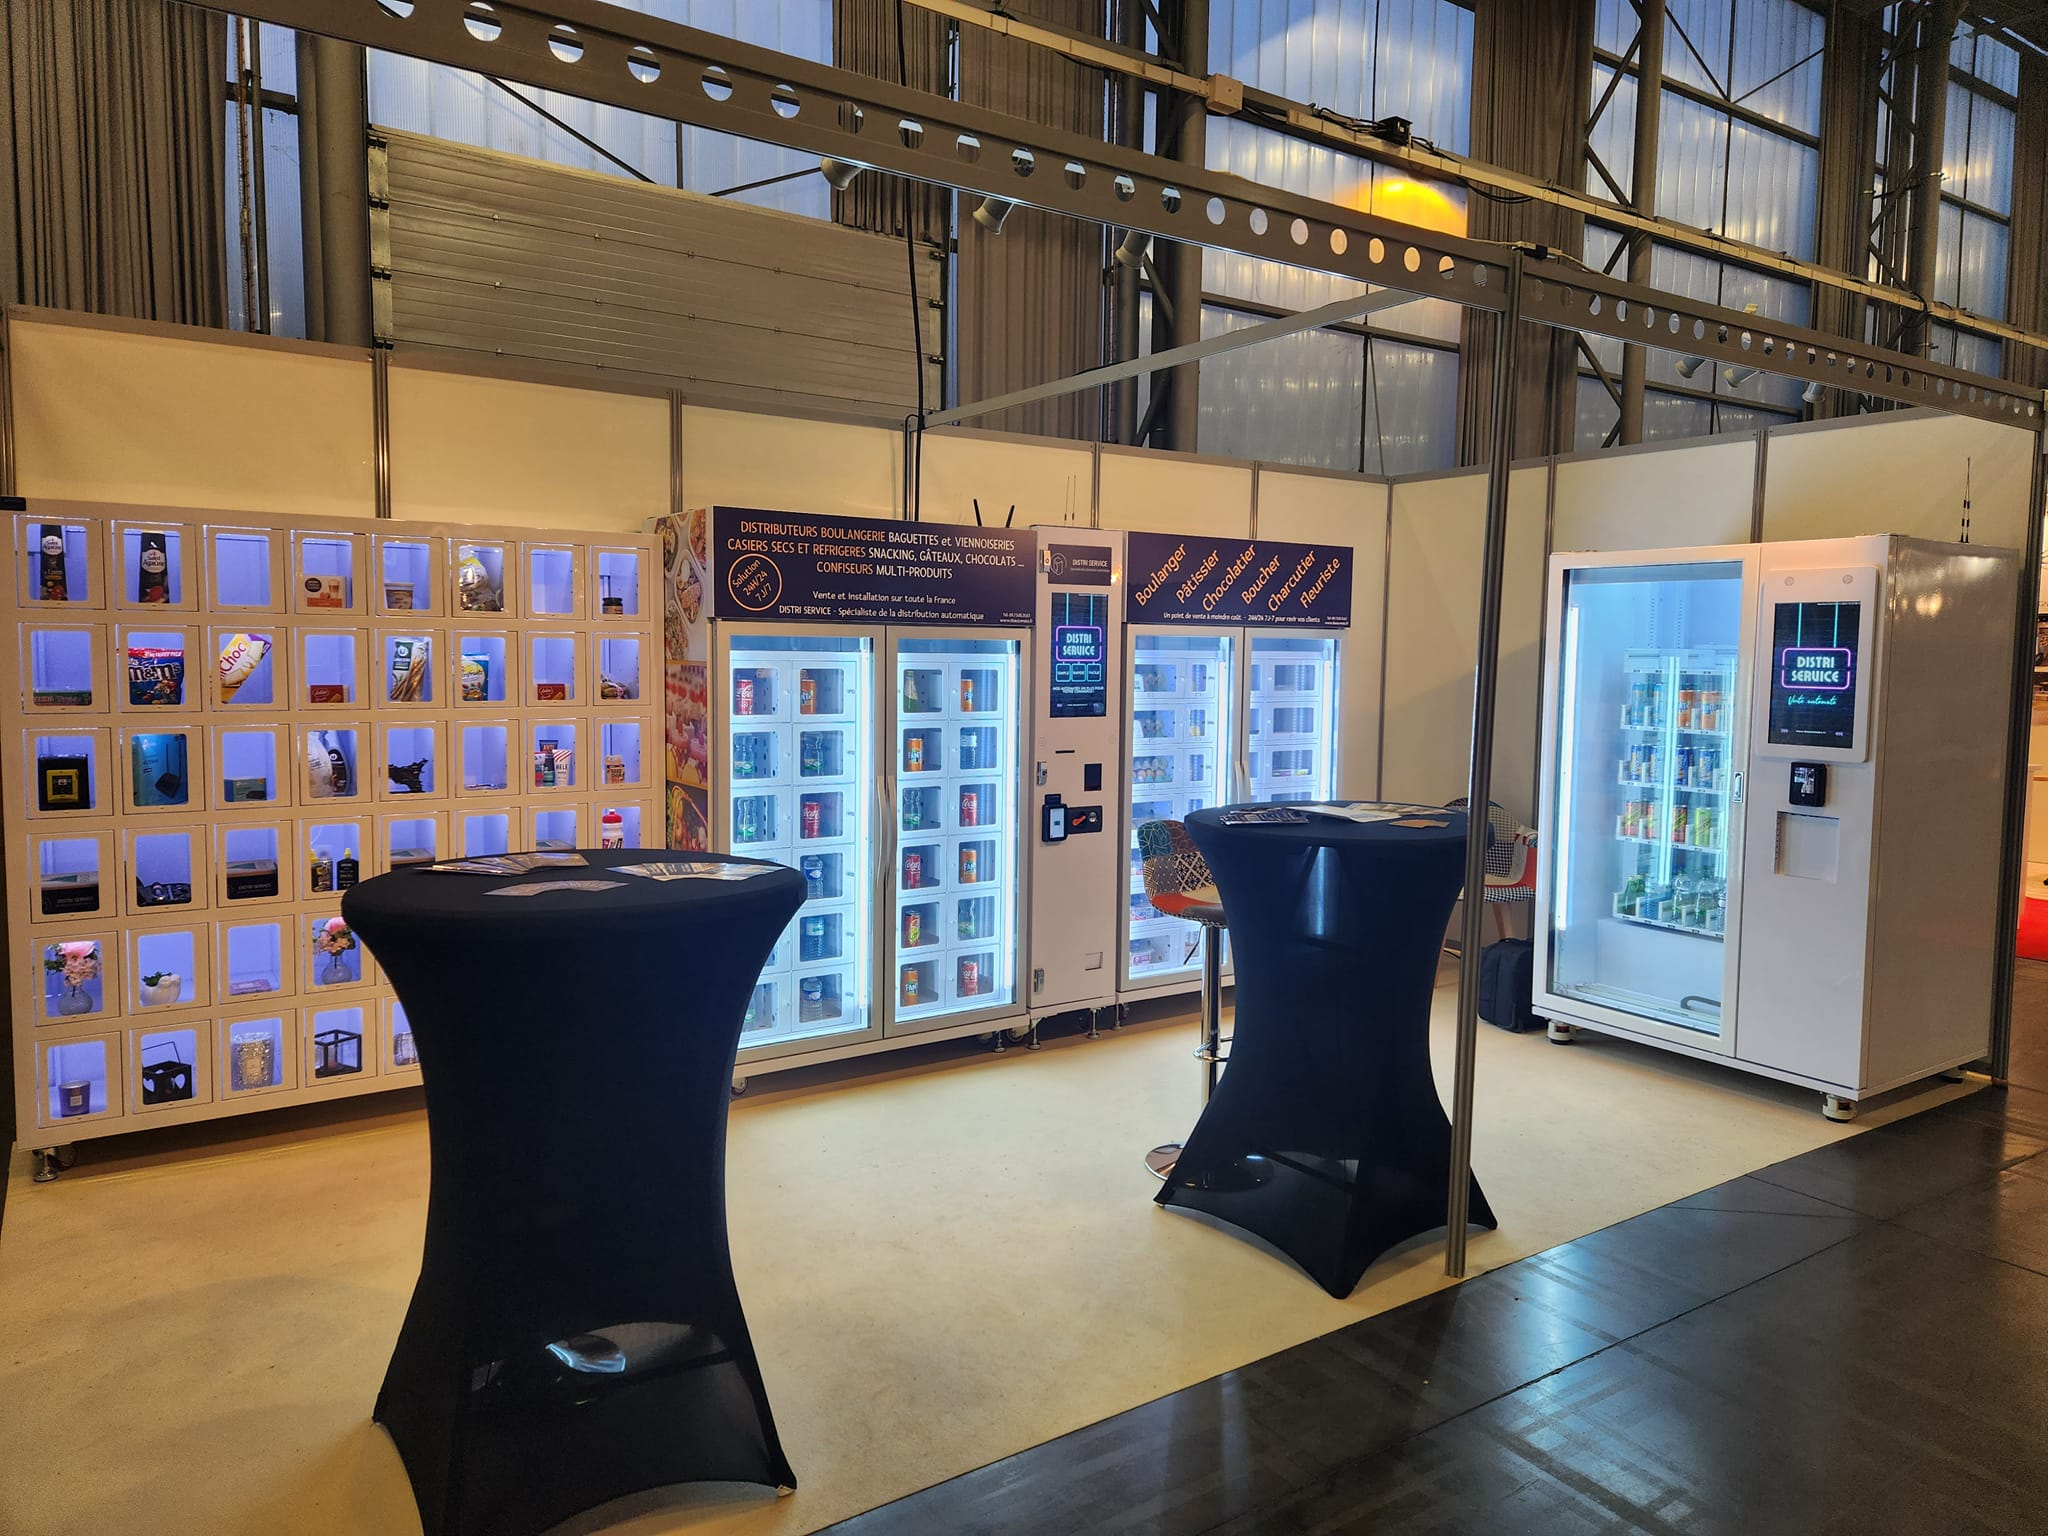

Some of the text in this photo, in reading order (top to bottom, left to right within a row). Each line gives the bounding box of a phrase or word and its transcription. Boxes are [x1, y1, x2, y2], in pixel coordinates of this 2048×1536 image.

[740, 521, 1015, 551] DISTRIBUTEURS BOULANGERIE BAGUETTES et VIENNOISERIES
[727, 538, 768, 552] CASIERS
[771, 541, 795, 554] SECS
[797, 543, 810, 555] ET
[812, 543, 866, 558] REFRIGERES
[868, 547, 917, 562] SNACKING,
[919, 549, 963, 564] GÂTEAUX,
[965, 554, 1016, 567] CHOCOLATS
[1072, 559, 1108, 568] DISTRI SERVICE
[732, 559, 761, 588] Solution
[742, 570, 768, 596] 24H/24
[816, 561, 953, 580] CONFISEURS MULTI-PRODUITS
[1134, 543, 1188, 607] Boulanger
[1175, 549, 1220, 604] Pâtissier
[1202, 543, 1257, 612] Chocolatier
[1241, 554, 1282, 606] Boucher
[1267, 550, 1317, 612] Charcutier
[1299, 557, 1341, 609] Fleuriste
[812, 590, 836, 600] Vente
[837, 592, 847, 600] et
[926, 595, 933, 603] la
[779, 605, 802, 614] DISTRI
[803, 606, 832, 615] SERVICE
[838, 607, 877, 618] Spécialiste
[878, 608, 888, 617] de
[889, 608, 896, 617] la
[897, 609, 939, 619] distribution
[941, 611, 985, 622] automatique
[1171, 612, 1185, 620] point
[1305, 615, 1320, 623] clients
[1062, 645, 1096, 656] SERVICE
[1066, 633, 1092, 644] DISTRI
[1796, 656, 1835, 669] DISTRI
[1791, 670, 1839, 683] SERVICE
